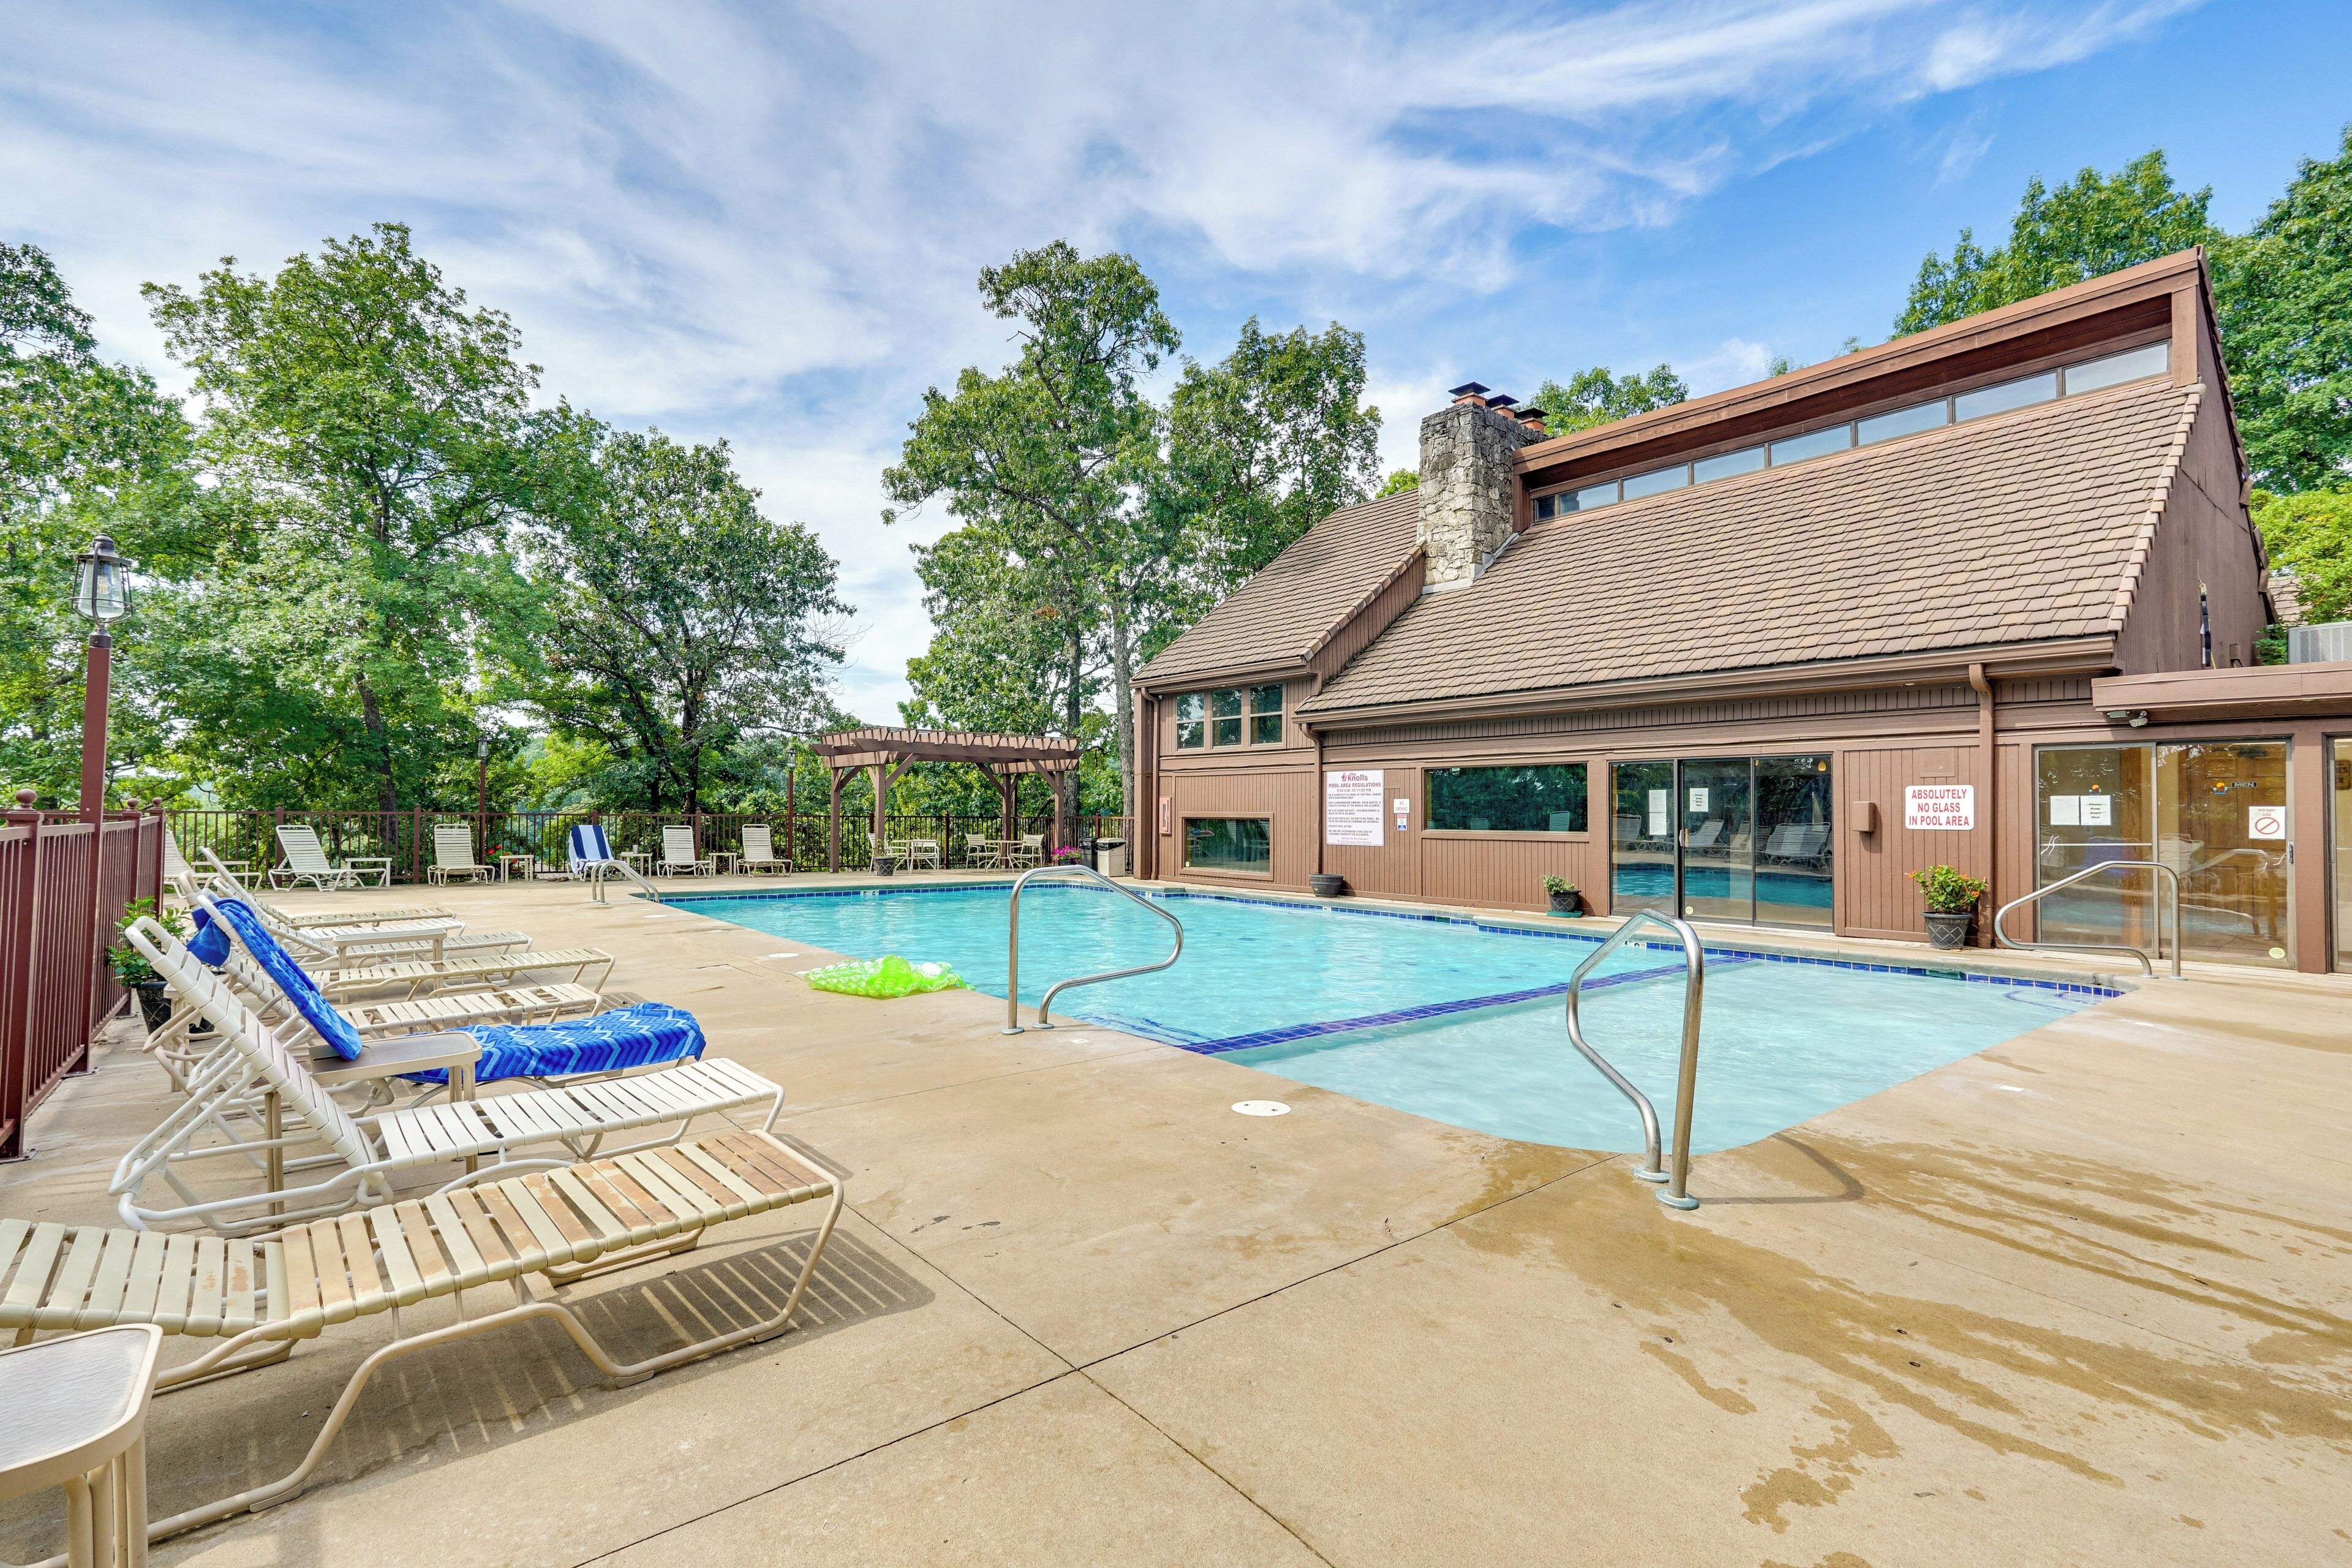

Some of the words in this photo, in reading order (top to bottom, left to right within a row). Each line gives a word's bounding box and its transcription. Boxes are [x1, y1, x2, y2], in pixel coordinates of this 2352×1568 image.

[1912, 789, 1967, 799] ABSOLUTELY
[1918, 803, 1929, 812] NO
[1933, 802, 1960, 812] GLASS
[1909, 816, 1917, 825] IN
[1921, 816, 1942, 825] POOL
[1945, 816, 1969, 826] AREA
